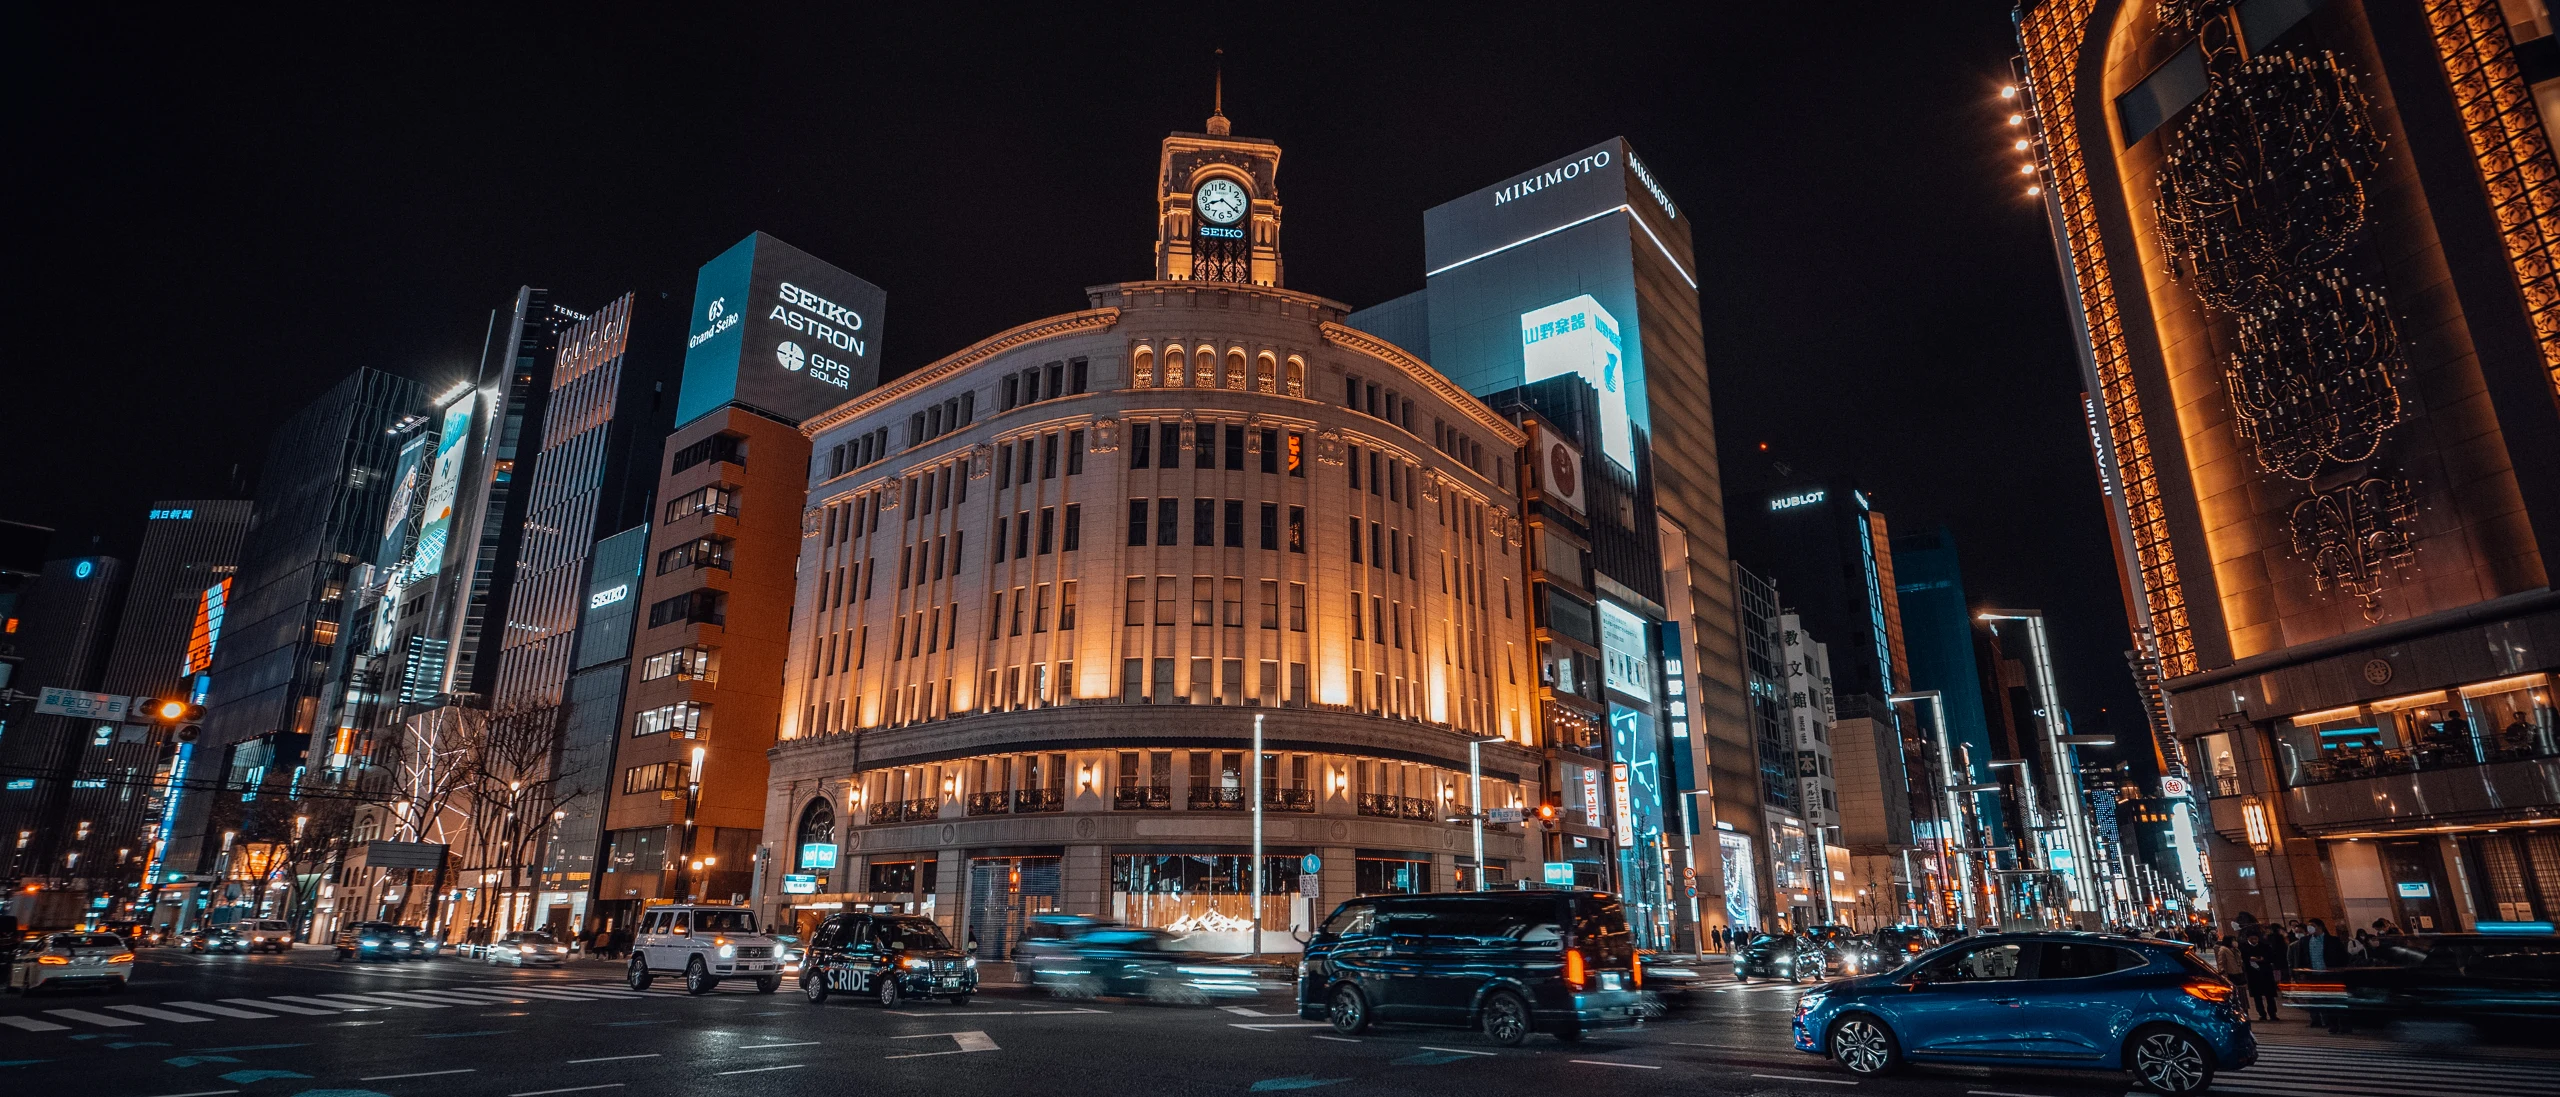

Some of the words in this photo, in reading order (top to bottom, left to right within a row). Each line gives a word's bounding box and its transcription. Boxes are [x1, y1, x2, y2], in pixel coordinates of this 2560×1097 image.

[1495, 151, 1610, 206] MIKIMOTO
[1628, 152, 1676, 219] MIKIMOTO
[1201, 227, 1243, 238] SEIKO
[554, 304, 590, 320] TENSH
[708, 296, 725, 322] GS
[780, 282, 862, 331] SEIKO
[690, 327, 715, 348] Grand
[715, 312, 738, 334] Seiko
[769, 304, 864, 356] ASTRON
[1524, 312, 1586, 344] 山野楽器
[810, 368, 848, 390] SOLAR
[812, 354, 850, 380] GPS
[1772, 491, 1824, 510] HUBLOT
[591, 584, 627, 608] SEIKO
[1784, 630, 1806, 708] 教文館
[45, 695, 121, 712] 銀座四丁目
[1800, 755, 1815, 773] 本
[1806, 782, 1818, 818] ナルニア国
[827, 969, 870, 991] S.RIDE
